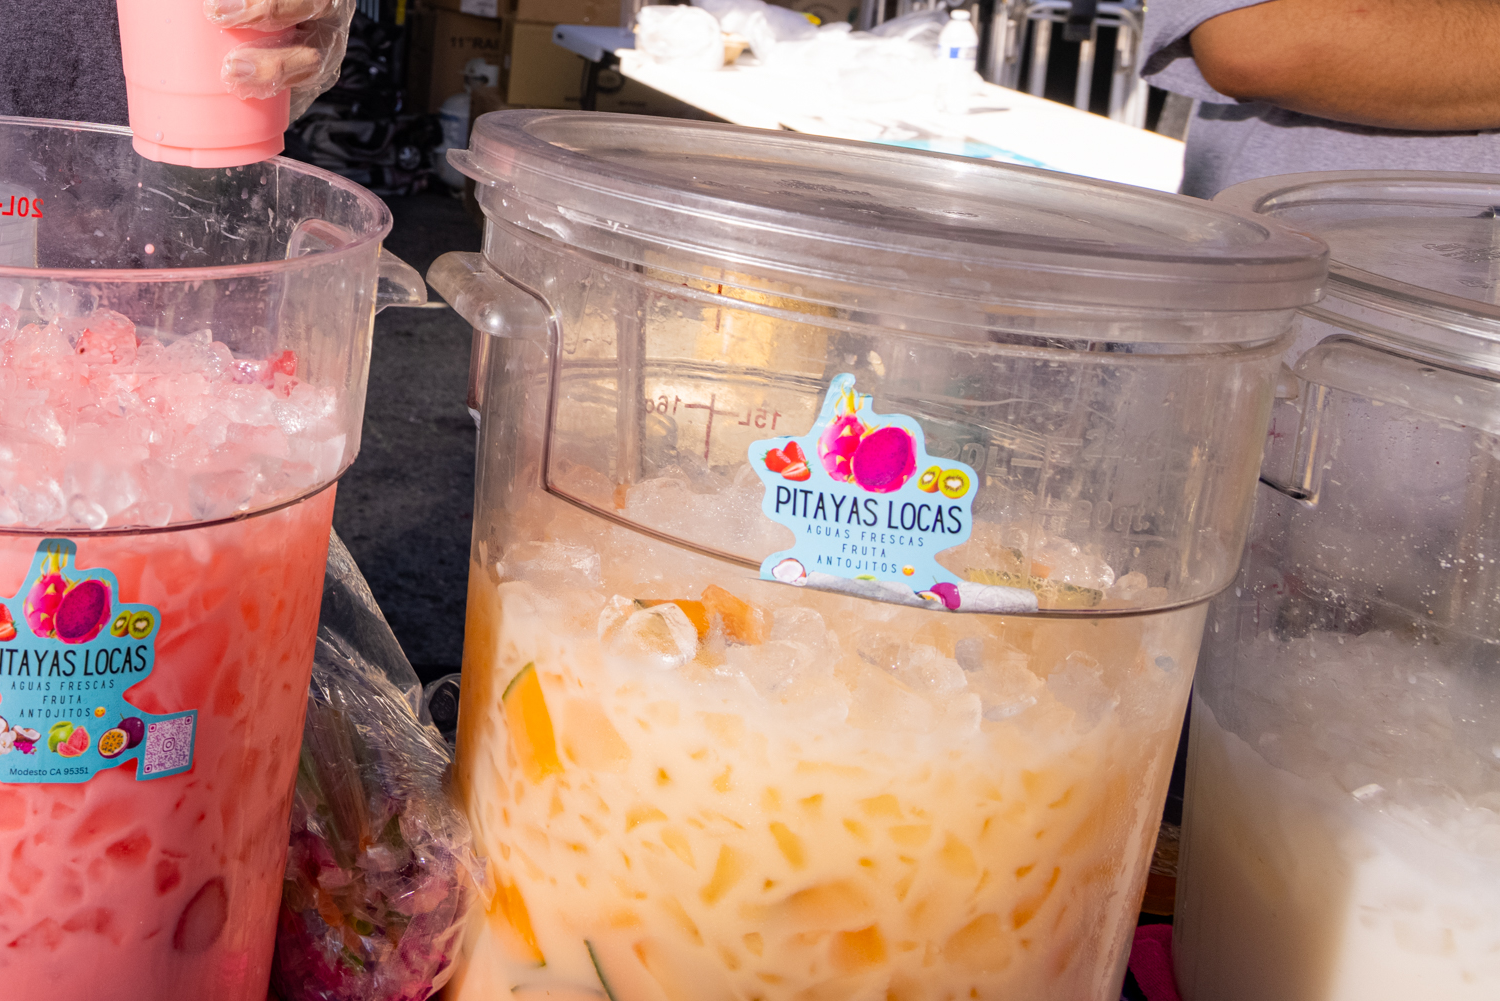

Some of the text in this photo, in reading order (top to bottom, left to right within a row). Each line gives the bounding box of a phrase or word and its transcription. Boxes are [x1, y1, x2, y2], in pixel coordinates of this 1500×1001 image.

[775, 485, 963, 535] PITAYAS LOCAS
[806, 524, 924, 547] AGUAS FRESCAS
[842, 543, 887, 558] FRUTA
[817, 554, 897, 574] ANTOJITOS
[83, 645, 148, 676] LOCAS
[11, 679, 115, 691] AGUAS FRESCAS
[42, 694, 82, 705] FRUTA
[19, 707, 91, 718] ANTOJITOS
[9, 766, 89, 776] Modesto CA 95351
